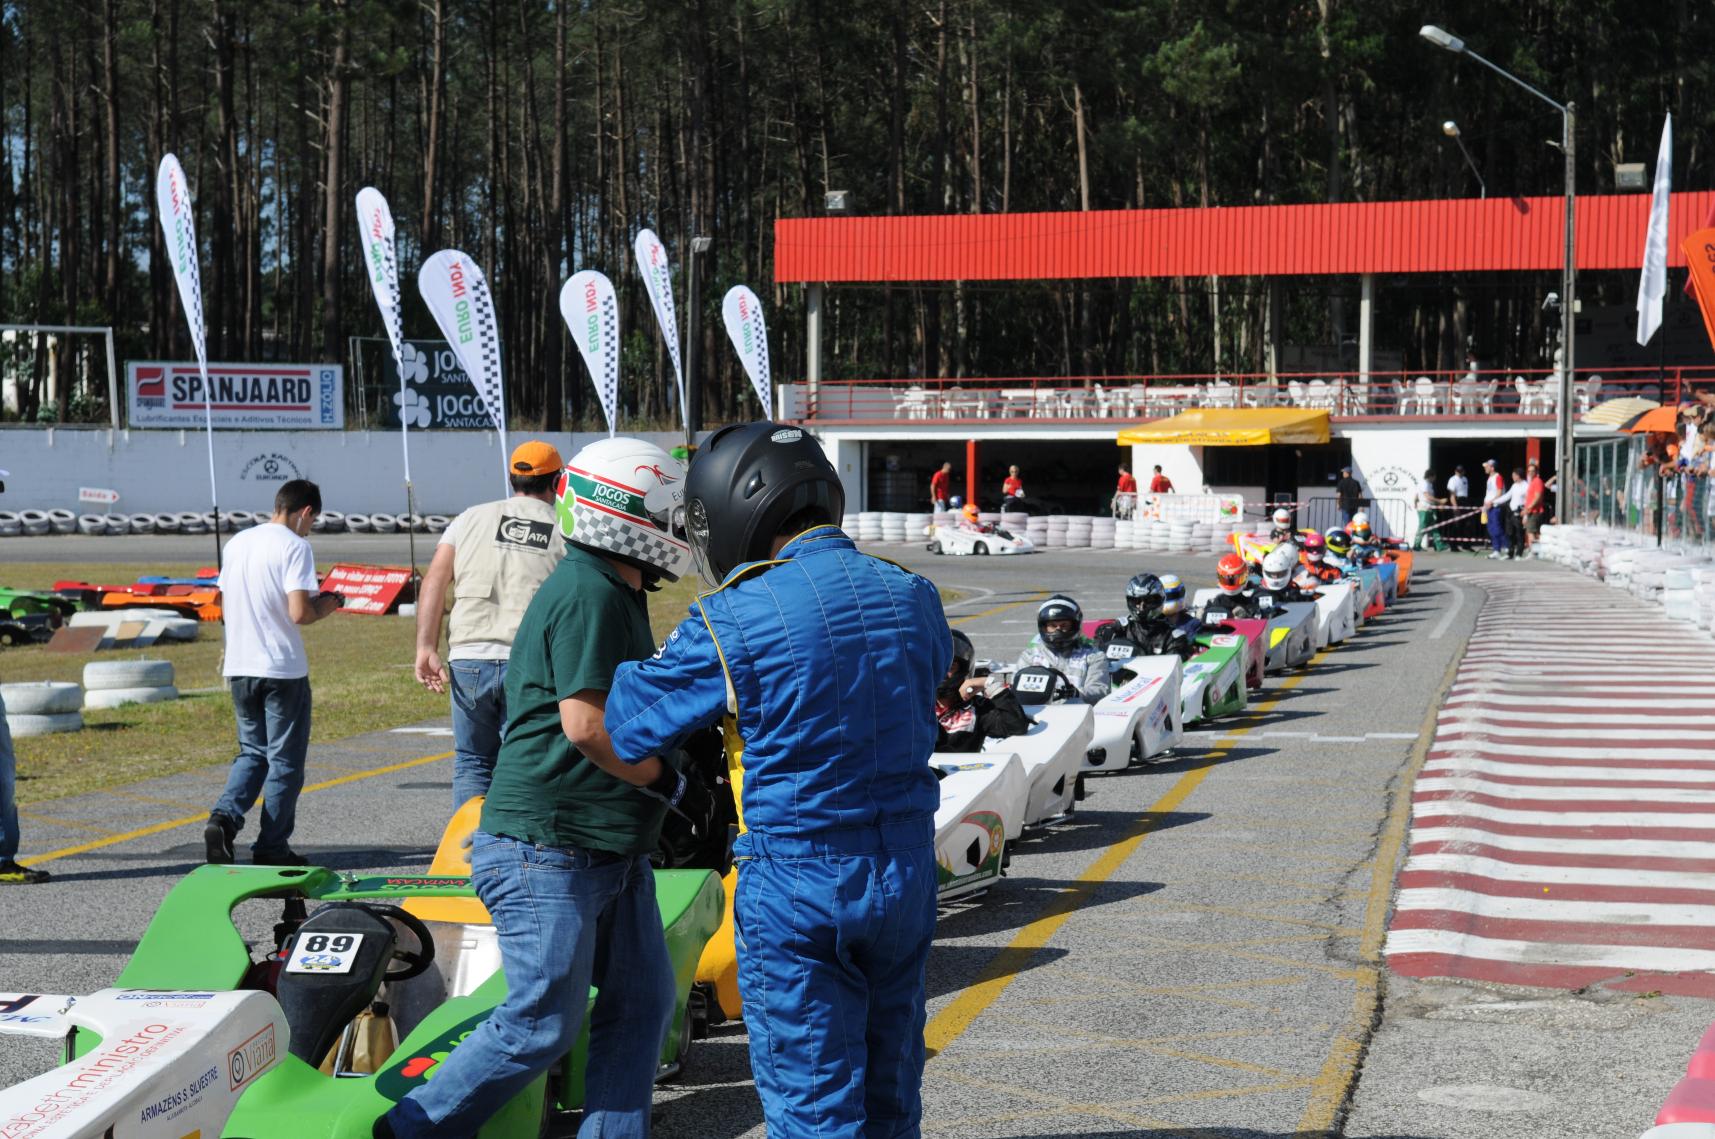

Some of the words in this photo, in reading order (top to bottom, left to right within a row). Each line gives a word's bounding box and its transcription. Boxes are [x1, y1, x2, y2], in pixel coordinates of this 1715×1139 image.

[172, 375, 312, 404] SPANJAARD
[437, 394, 488, 422] JOGO
[136, 414, 190, 424] Lubrificantes
[193, 415, 232, 425] Espciais
[242, 415, 274, 424] Aditivos
[444, 416, 496, 427] SANTACAS
[592, 483, 630, 505] JOGOS
[305, 935, 354, 952] 89
[140, 1093, 182, 1124] ARMAZÉNS
[190, 1066, 219, 1097] SILVESTRE
